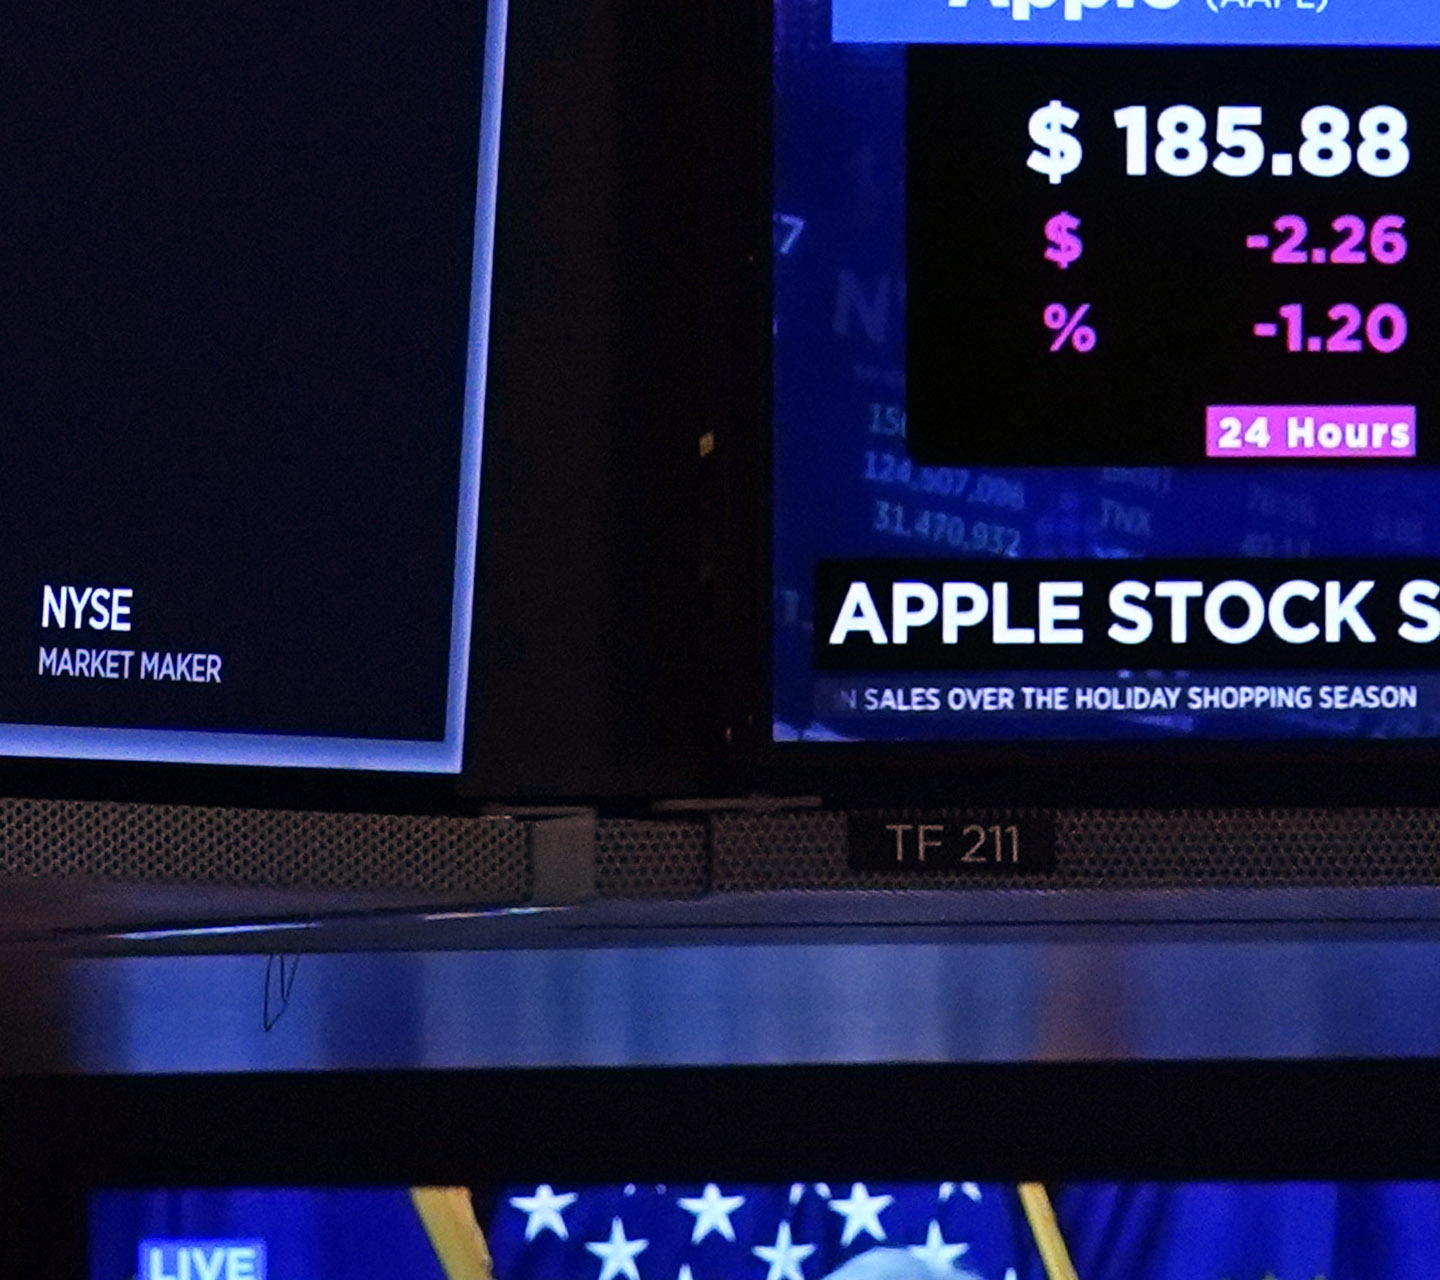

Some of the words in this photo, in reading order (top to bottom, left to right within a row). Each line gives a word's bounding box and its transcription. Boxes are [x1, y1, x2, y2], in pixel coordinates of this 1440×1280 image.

[1113, 103, 1411, 178] 185.88
[1245, 213, 1409, 265] -2.26
[1252, 302, 1409, 354] -1.20
[1217, 417, 1272, 449] 24
[1285, 416, 1411, 449] Hours
[40, 584, 134, 632] NYSE
[828, 580, 1085, 645] APPLE
[1107, 579, 1377, 645] STOCK
[37, 645, 134, 680] MARKET
[139, 651, 223, 683] MAKER
[885, 823, 943, 863] TF
[960, 823, 1020, 864] 211
